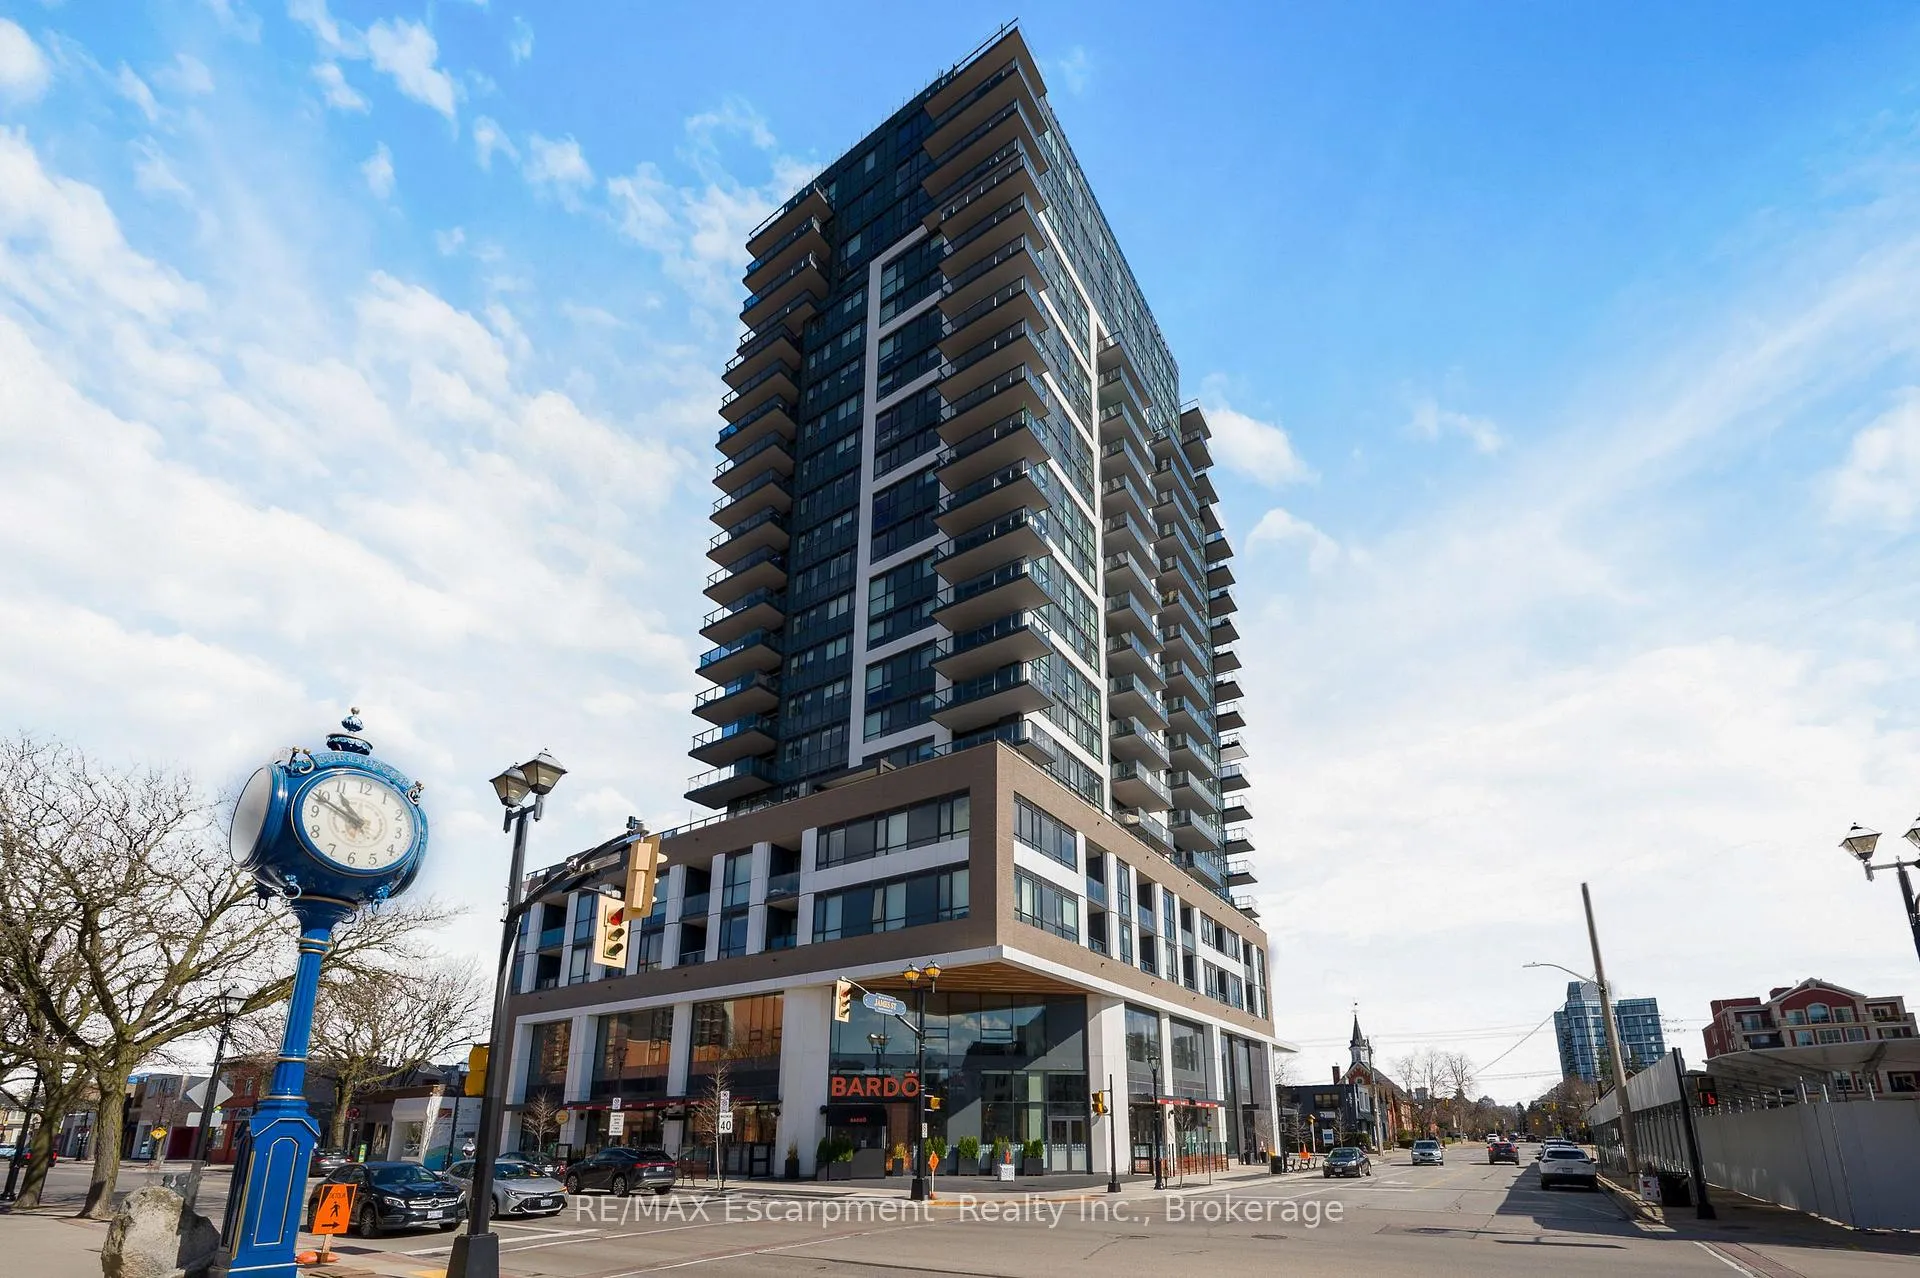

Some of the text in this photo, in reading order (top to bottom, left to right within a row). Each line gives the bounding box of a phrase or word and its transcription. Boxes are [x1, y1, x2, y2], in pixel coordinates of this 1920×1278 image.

[335, 781, 346, 795] 11
[359, 781, 372, 796] 12
[382, 792, 389, 805] 1
[310, 805, 320, 819] 9
[395, 809, 403, 821] 2
[310, 825, 320, 839] 8
[394, 826, 402, 839] 3
[328, 843, 337, 857] 7
[386, 844, 395, 857] 4
[347, 852, 356, 866] 6
[368, 852, 378, 866] 5
[720, 1120, 732, 1131] 40
